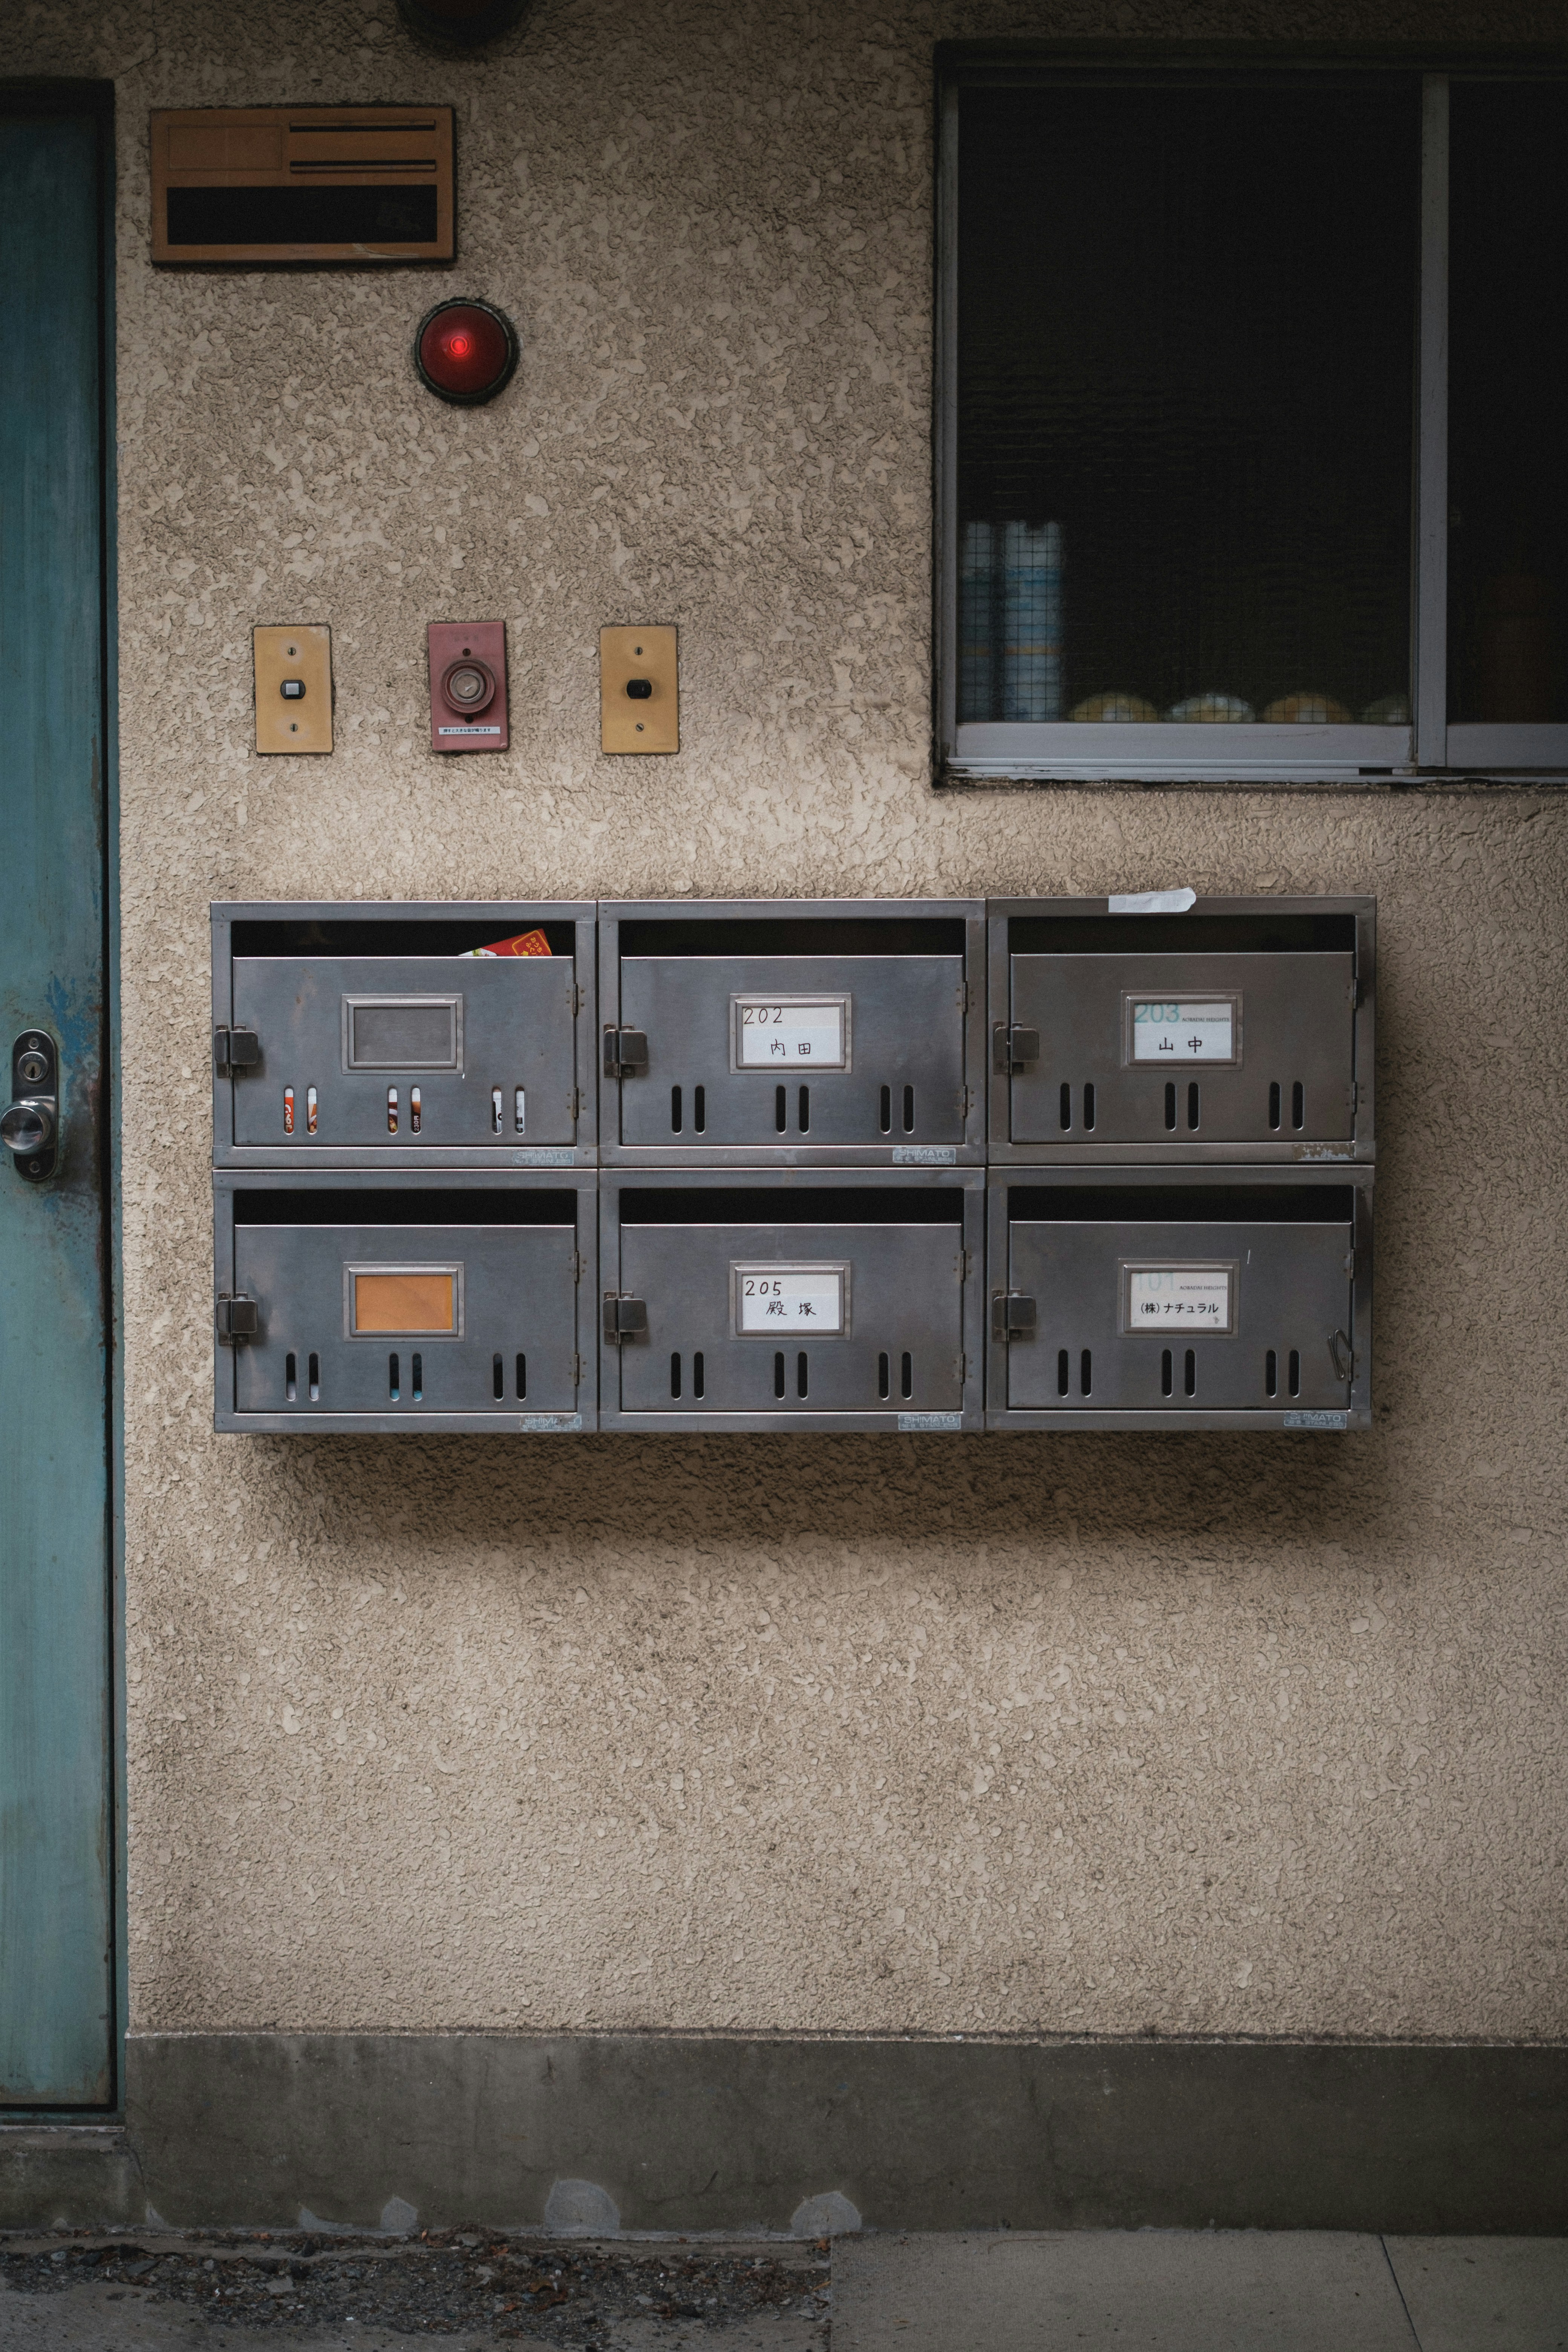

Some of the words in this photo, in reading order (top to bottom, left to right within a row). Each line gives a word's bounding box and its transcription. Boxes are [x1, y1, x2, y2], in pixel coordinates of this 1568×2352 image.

[744, 1007, 782, 1024] 202
[1135, 1003, 1179, 1023] 203
[771, 1039, 810, 1056] 内田
[1159, 1036, 1202, 1053] 山中
[745, 1280, 781, 1295] 205
